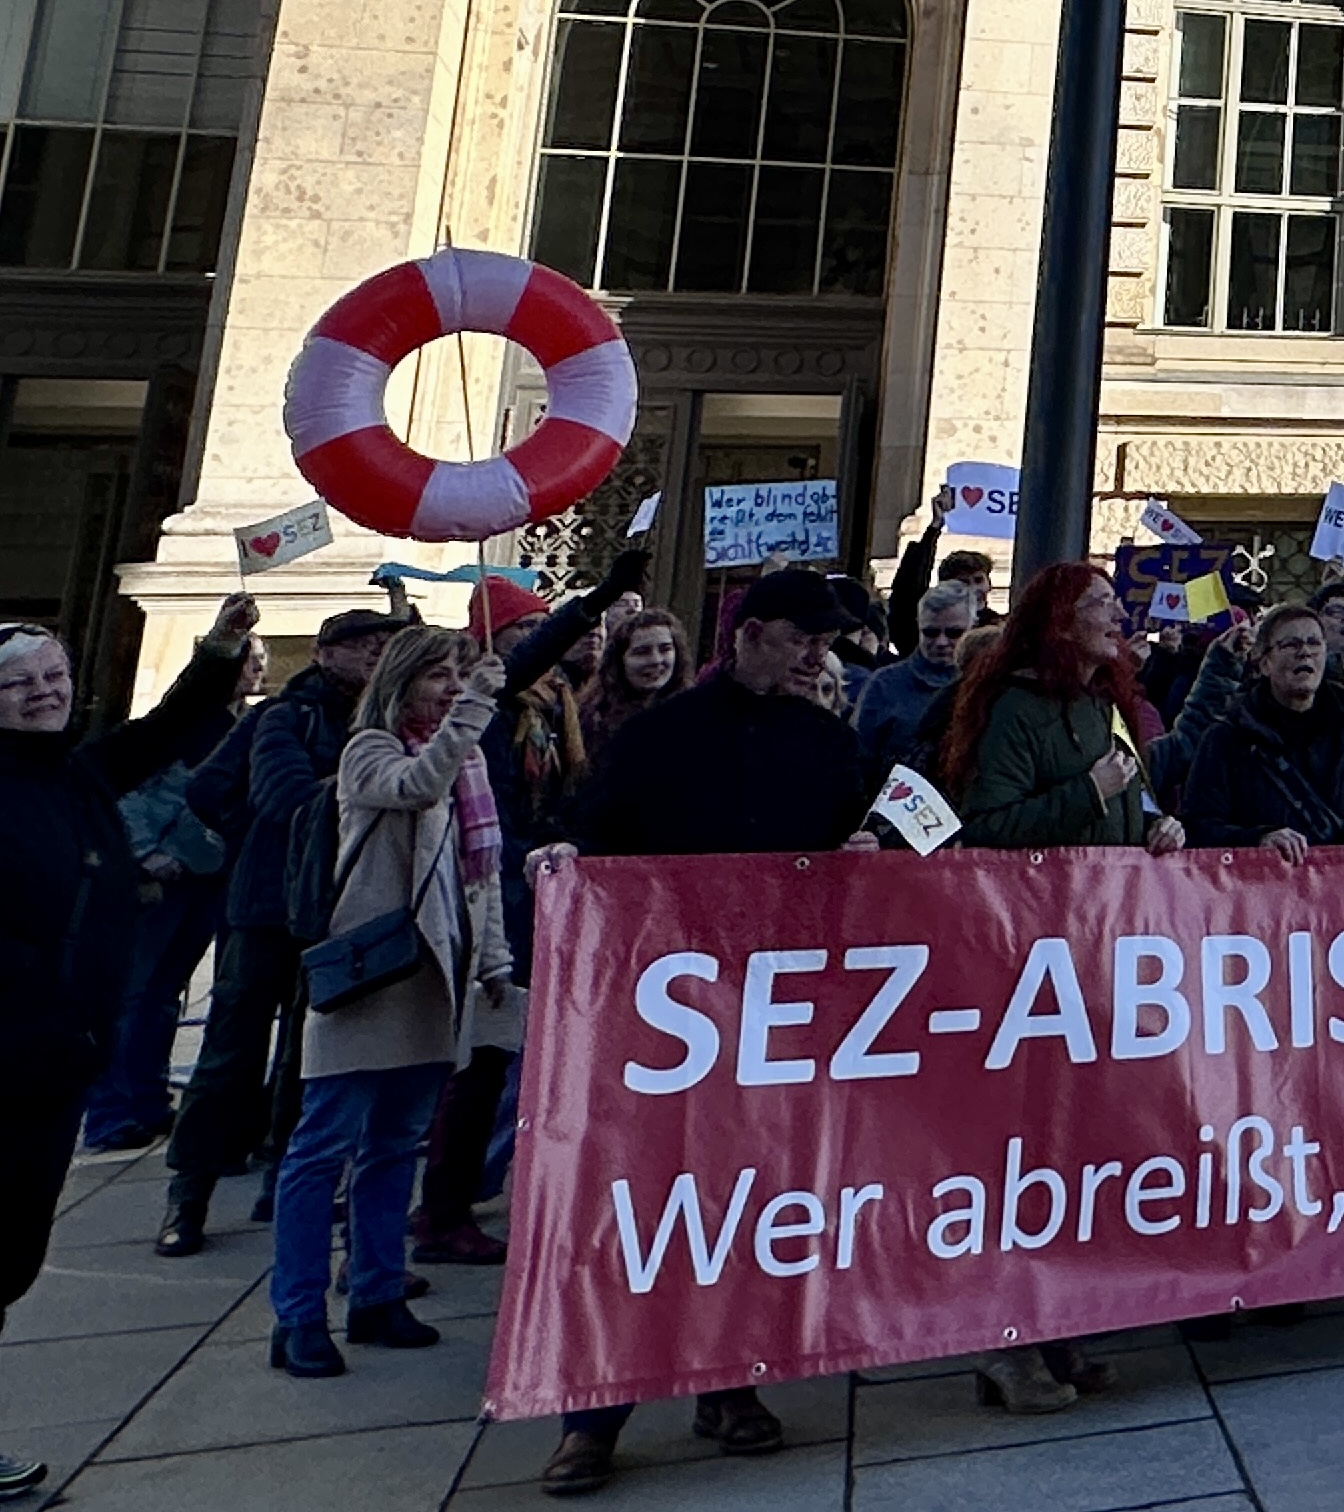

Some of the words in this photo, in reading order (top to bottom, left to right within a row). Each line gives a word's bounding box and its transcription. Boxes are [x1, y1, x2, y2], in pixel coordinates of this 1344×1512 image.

[709, 489, 746, 509] Wer
[755, 485, 807, 508] blind
[903, 794, 943, 838] SEZ
[611, 1168, 884, 1295] Wer
